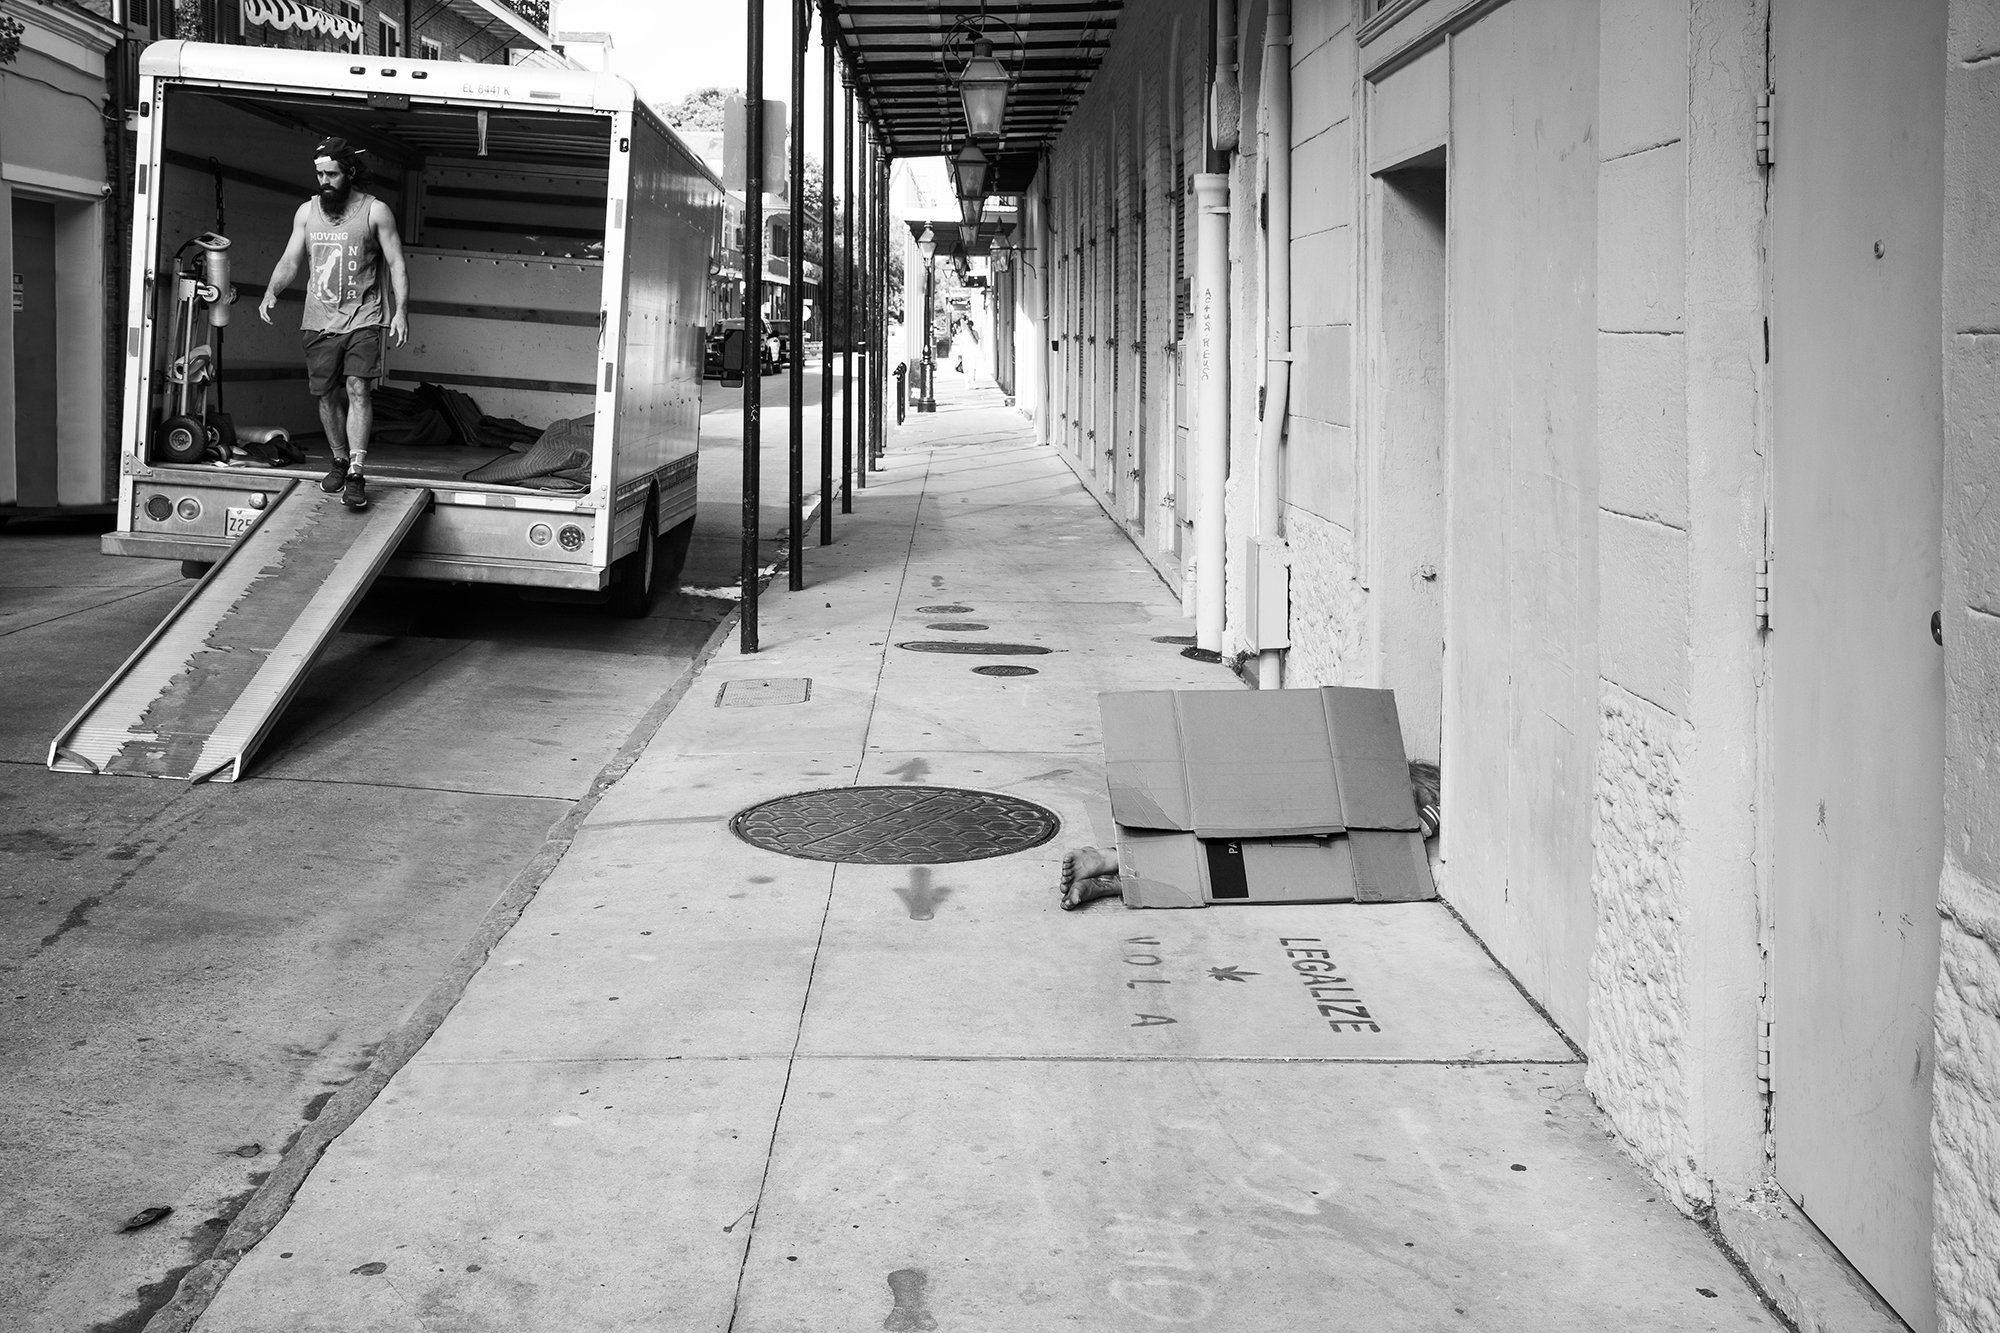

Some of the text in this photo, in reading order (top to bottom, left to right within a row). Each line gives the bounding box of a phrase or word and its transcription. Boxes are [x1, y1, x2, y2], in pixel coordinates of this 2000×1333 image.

[310, 232, 349, 241] MOVING
[346, 245, 359, 300] NOLA
[1280, 937, 1381, 1033] LEGALIZE
